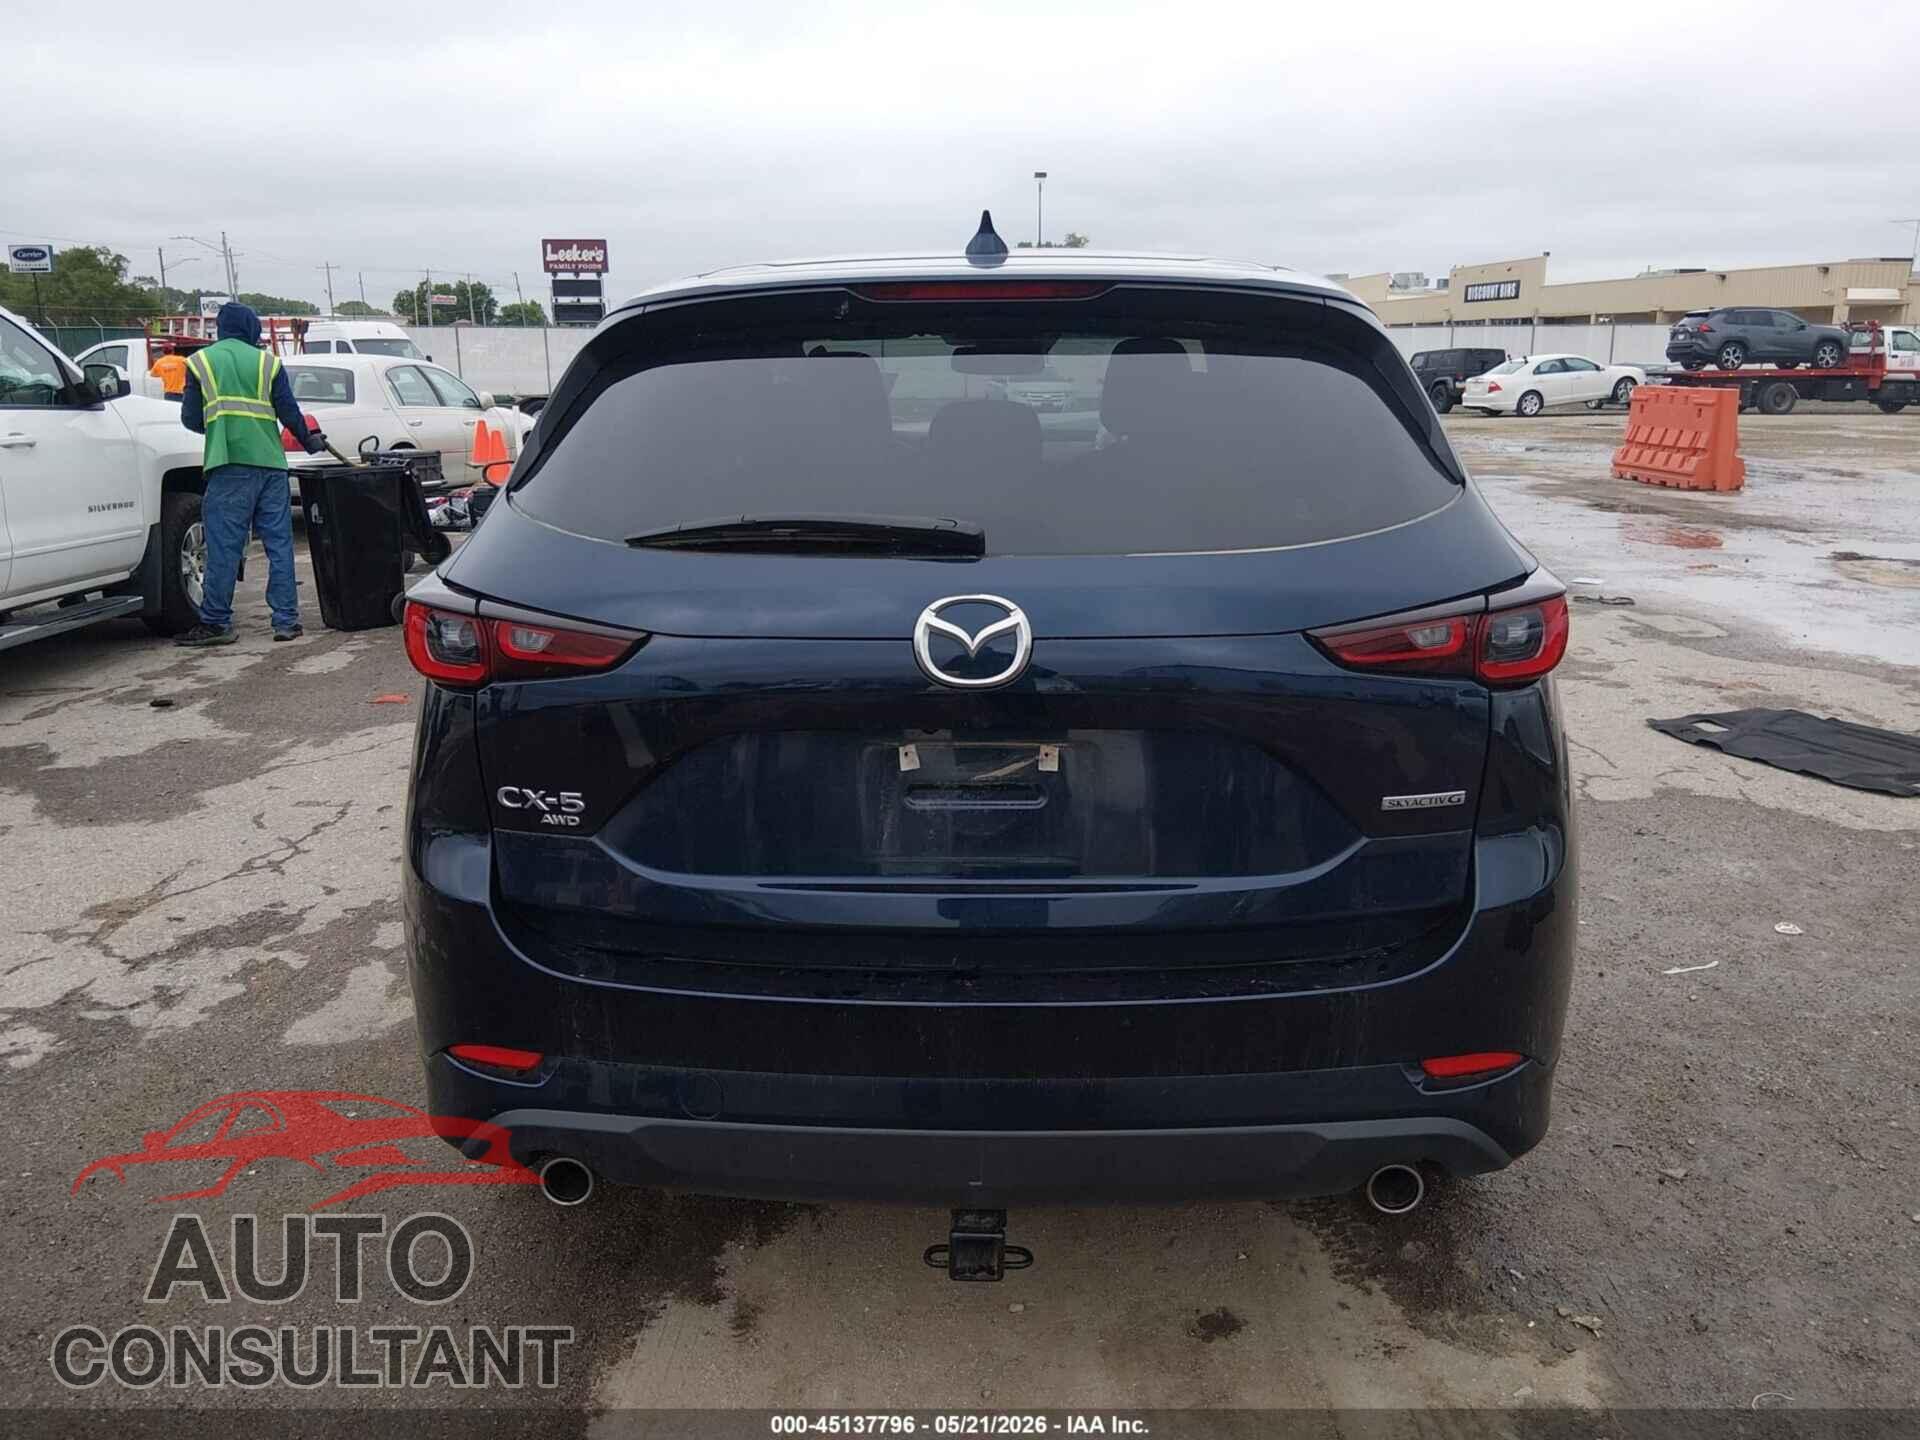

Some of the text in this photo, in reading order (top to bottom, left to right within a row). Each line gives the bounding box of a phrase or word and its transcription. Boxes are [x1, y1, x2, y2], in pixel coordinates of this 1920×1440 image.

[546, 243, 604, 262] Leeker's
[497, 786, 584, 812] CX-5
[540, 814, 580, 826] AWD
